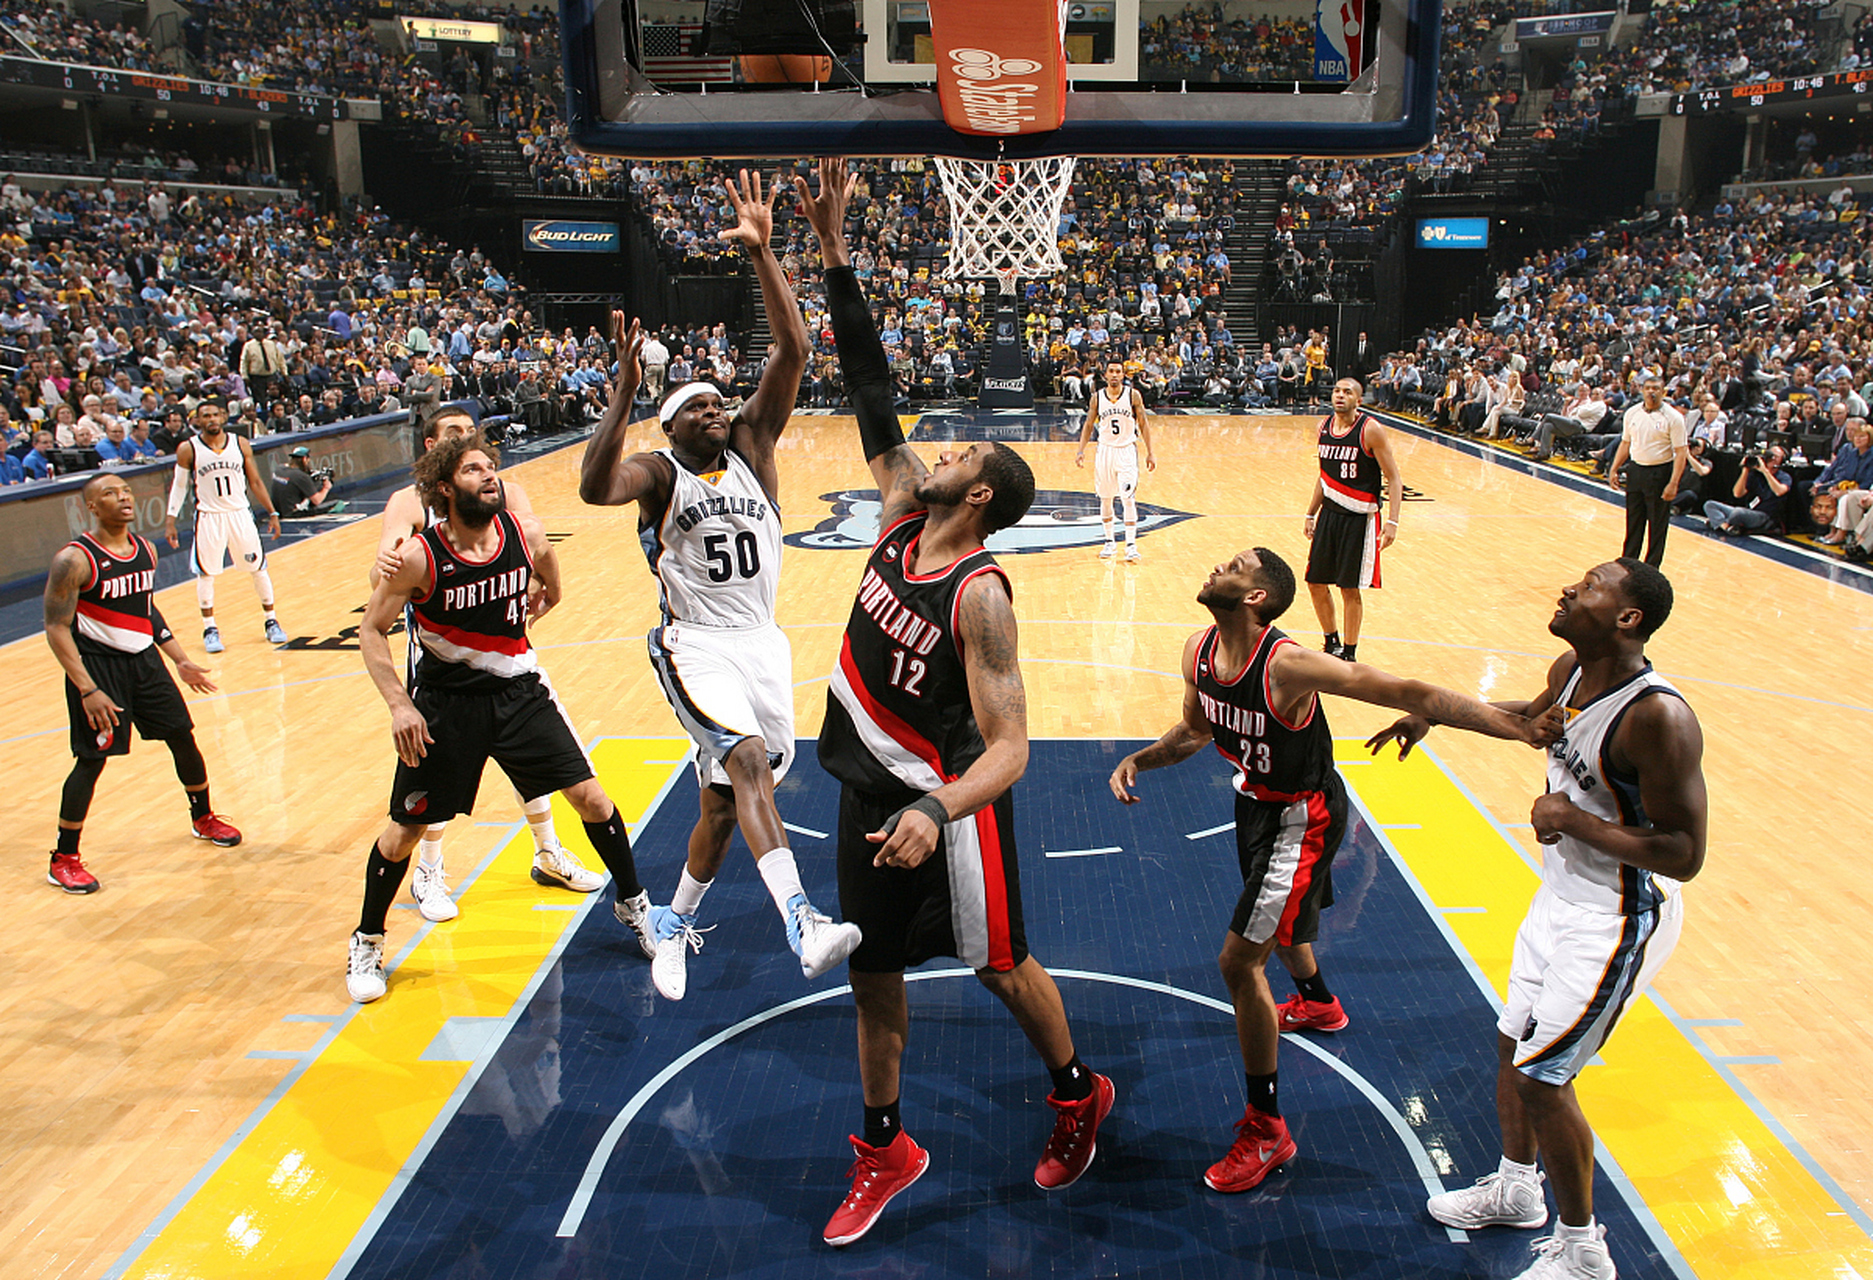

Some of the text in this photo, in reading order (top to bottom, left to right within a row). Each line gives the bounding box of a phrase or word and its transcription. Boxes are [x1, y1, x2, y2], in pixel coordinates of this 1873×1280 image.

[1319, 60, 1345, 76] NBA
[64, 77, 73, 88] 0
[131, 75, 190, 92] GRIZZLIES
[200, 84, 229, 97] 10:46
[1732, 82, 1785, 98] GRIZZLIES
[1793, 77, 1823, 91] 10:46
[156, 89, 171, 100] 50
[1750, 95, 1764, 106] 50
[332, 108, 339, 118] 0
[1676, 103, 1683, 114] 0
[569, 231, 614, 241] LIGHT
[1111, 419, 1120, 435] 5
[1340, 462, 1357, 479] 88
[215, 475, 232, 497] 11
[676, 496, 767, 532] GRIZZLIES
[704, 530, 760, 583] 50
[101, 569, 155, 599] PORTLAN
[443, 565, 527, 611] PORTLAND
[858, 566, 943, 656] PORTLAND
[889, 647, 927, 698] 12
[1239, 738, 1272, 774] 23
